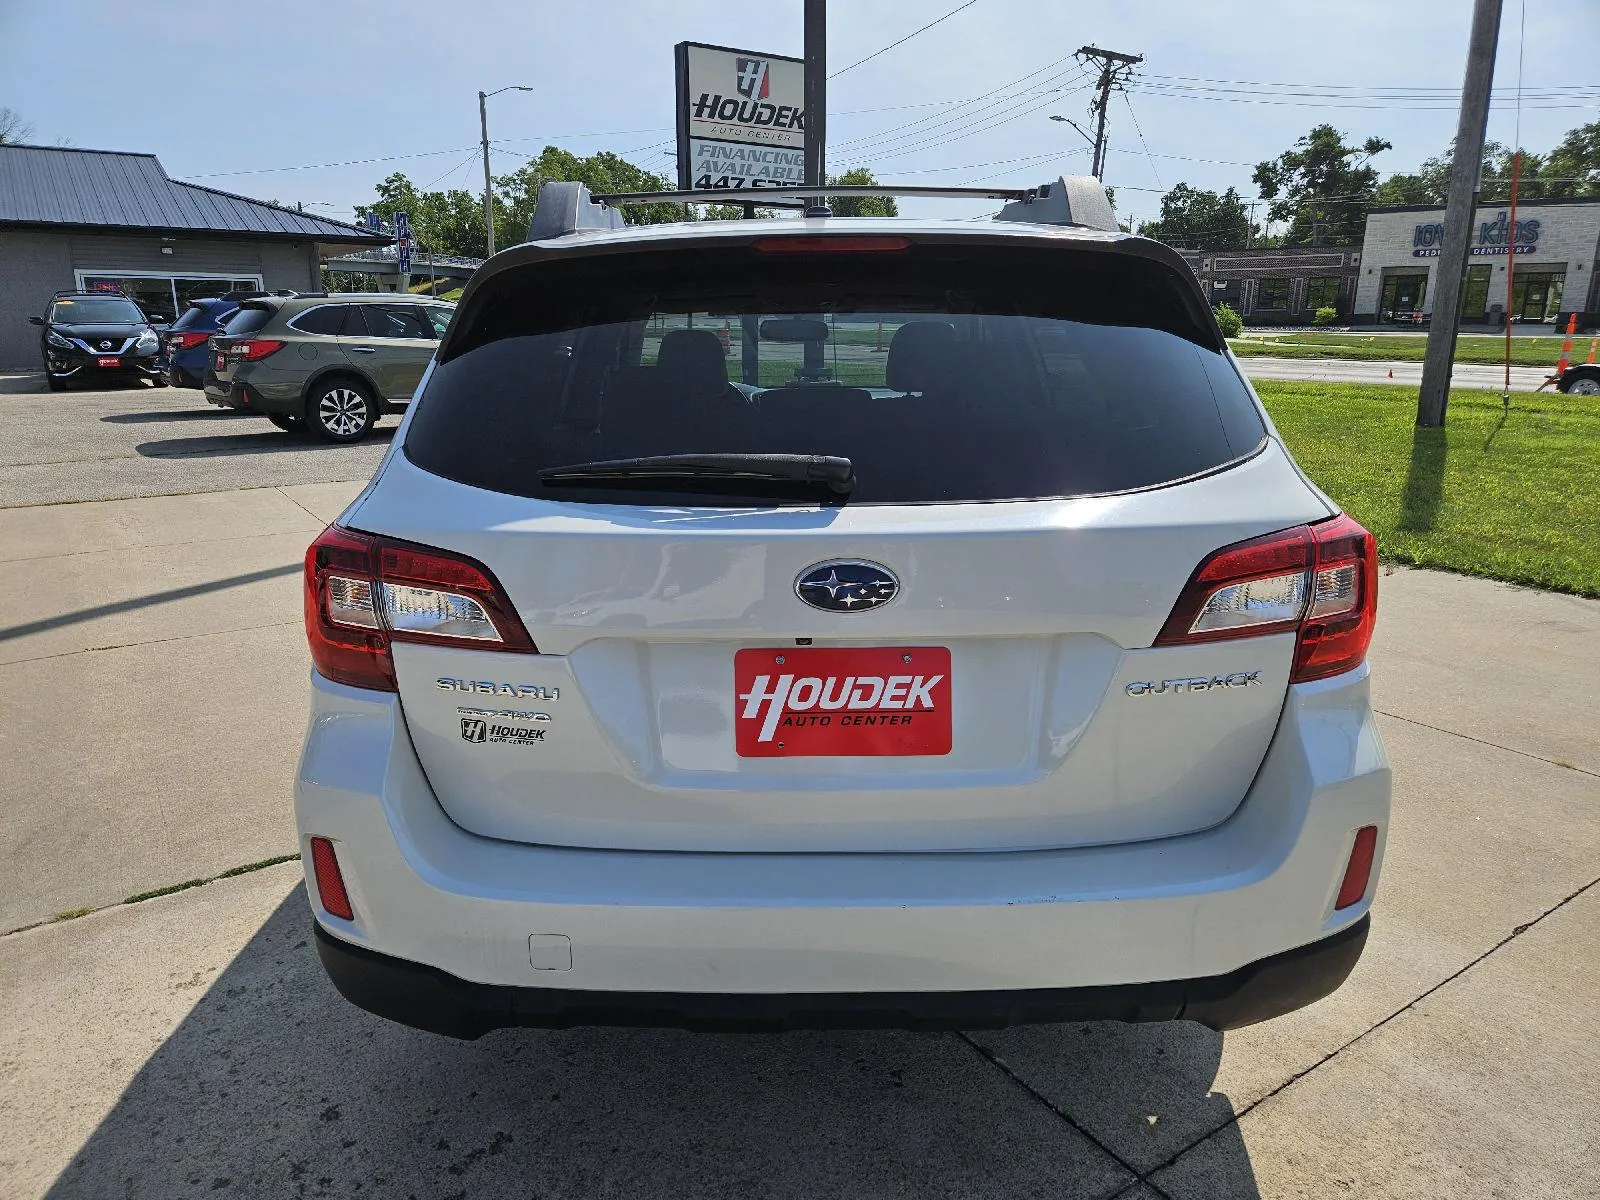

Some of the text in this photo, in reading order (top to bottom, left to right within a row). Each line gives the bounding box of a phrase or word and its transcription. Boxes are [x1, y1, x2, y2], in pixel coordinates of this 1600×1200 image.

[692, 93, 805, 129] HOUDEK
[711, 126, 791, 141] AUTO CENTER
[697, 143, 804, 166] FINANCING
[696, 159, 804, 180] AVAILABLE
[1473, 246, 1529, 255] DENTISRY
[436, 677, 560, 701] SUBARU
[1125, 670, 1263, 697] OUTBACK
[739, 674, 944, 743] HOUDEK
[489, 724, 546, 739] HOUDEK
[782, 715, 913, 727] AUTO CENTER
